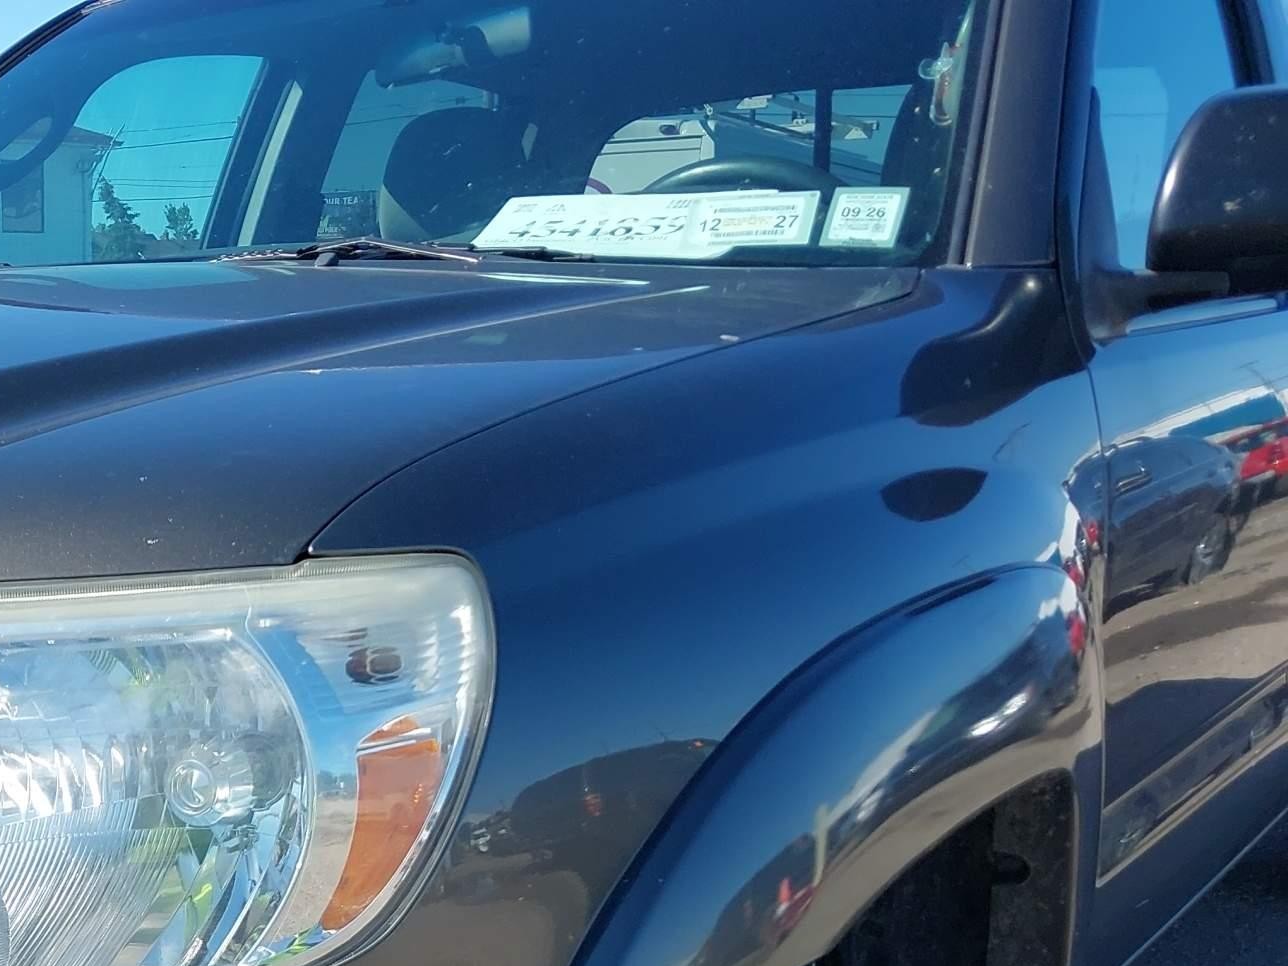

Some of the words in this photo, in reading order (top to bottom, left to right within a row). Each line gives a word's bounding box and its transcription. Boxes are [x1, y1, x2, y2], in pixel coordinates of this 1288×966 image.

[840, 206, 861, 218] 09
[866, 206, 886, 218] 26
[699, 218, 722, 233] 12
[773, 214, 799, 228] 27
